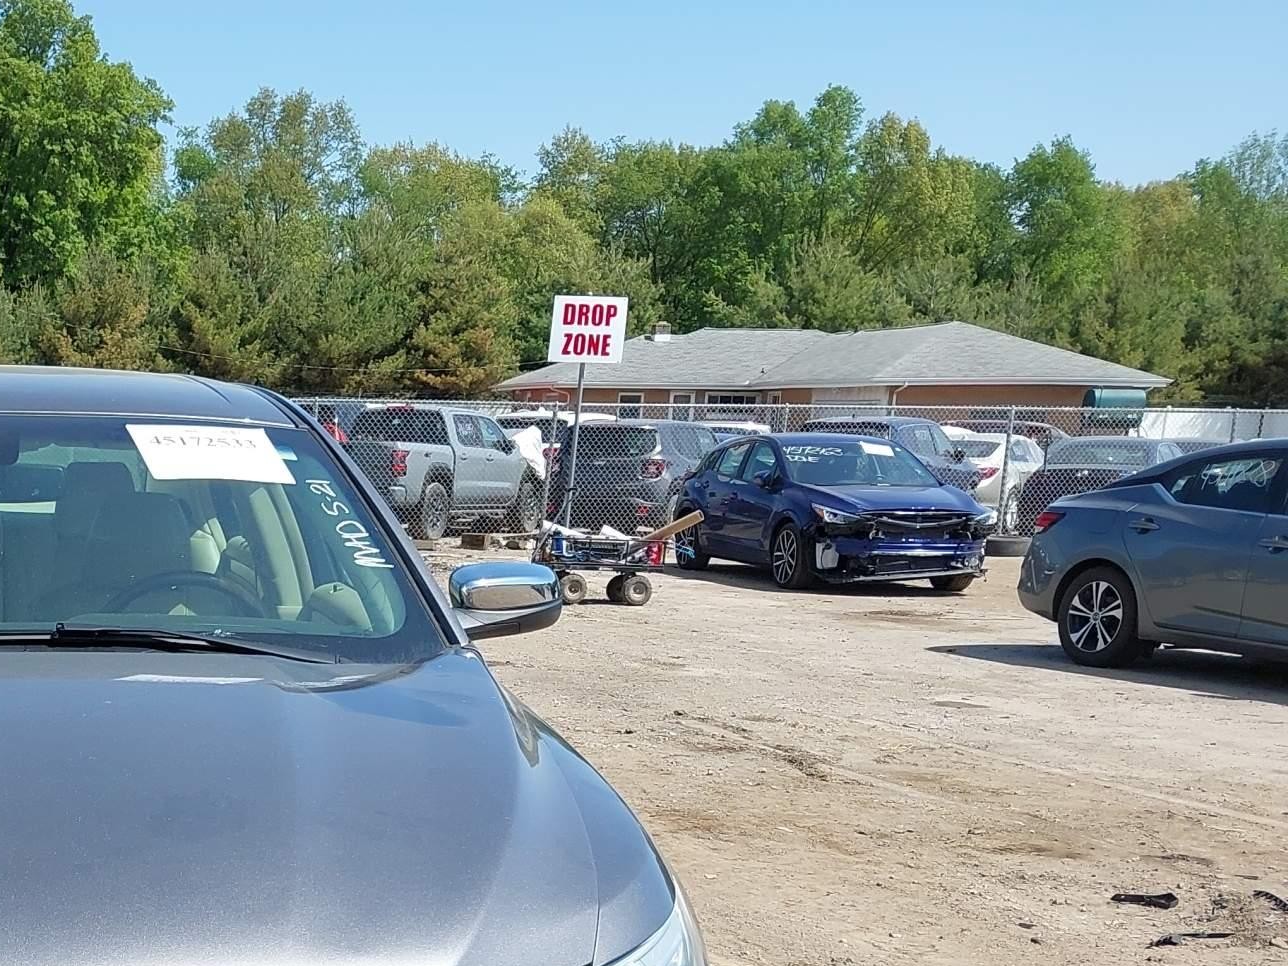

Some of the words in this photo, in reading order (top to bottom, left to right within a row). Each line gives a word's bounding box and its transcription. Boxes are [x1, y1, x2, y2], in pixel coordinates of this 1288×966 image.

[563, 303, 618, 327] DROP
[561, 333, 612, 357] ZONE
[150, 435, 257, 448] 45172533
